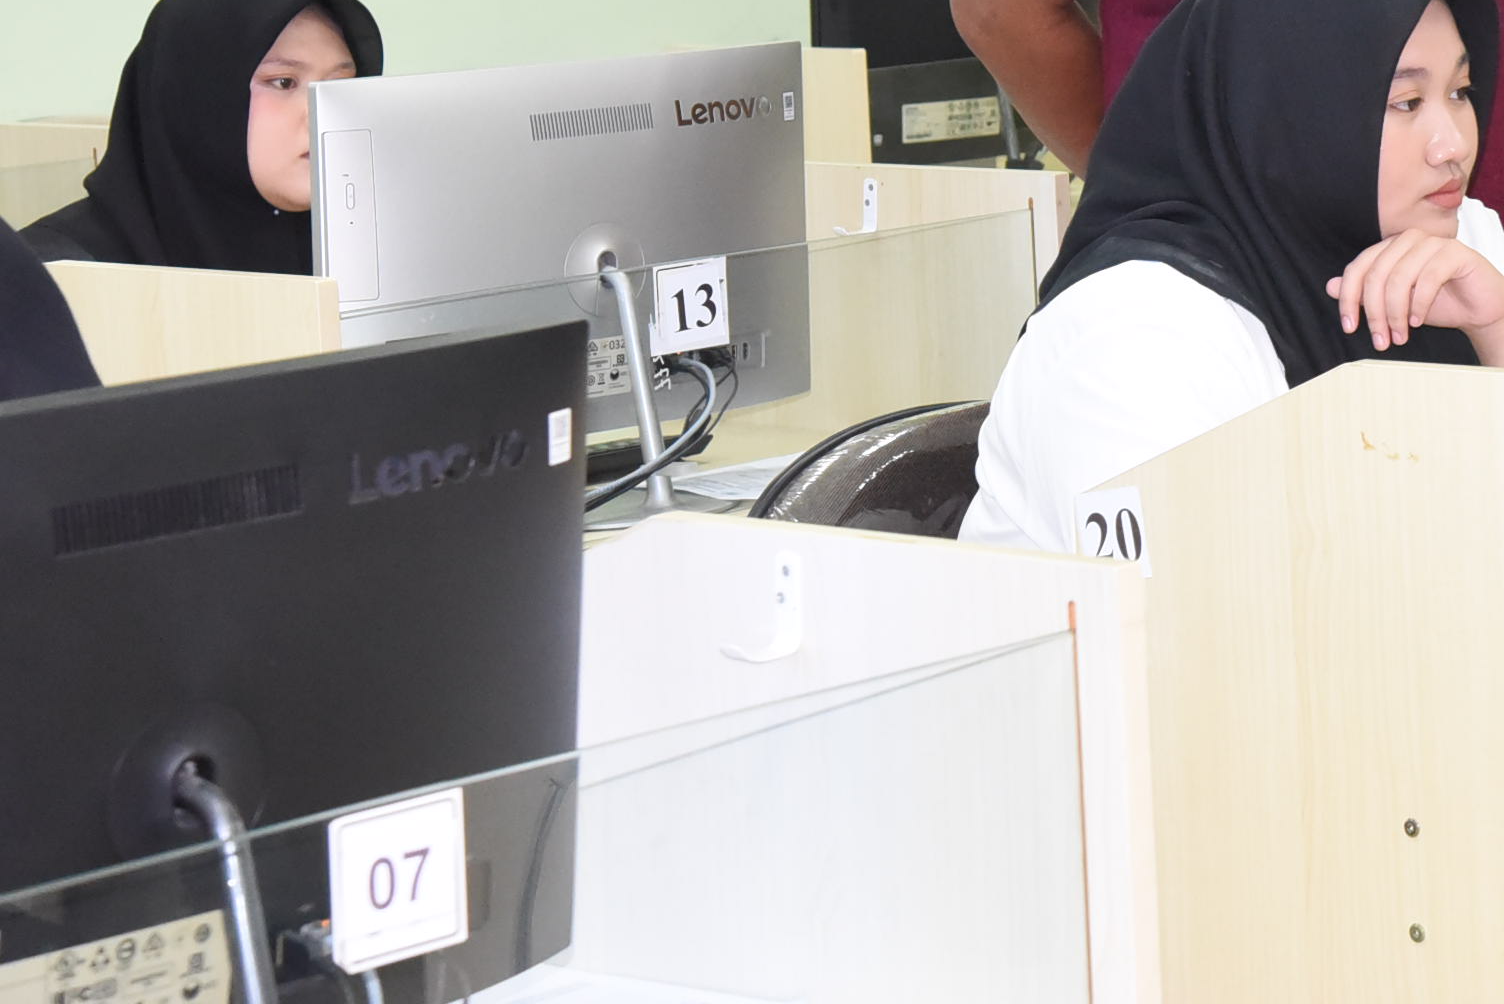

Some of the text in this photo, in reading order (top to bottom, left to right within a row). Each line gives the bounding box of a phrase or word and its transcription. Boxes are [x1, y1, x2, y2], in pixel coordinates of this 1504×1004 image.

[674, 95, 771, 126] Lenovo
[671, 283, 717, 333] 13
[609, 339, 626, 350] 032
[349, 429, 528, 504] Lenovo
[1085, 508, 1142, 562] 20
[369, 847, 430, 910] 07
